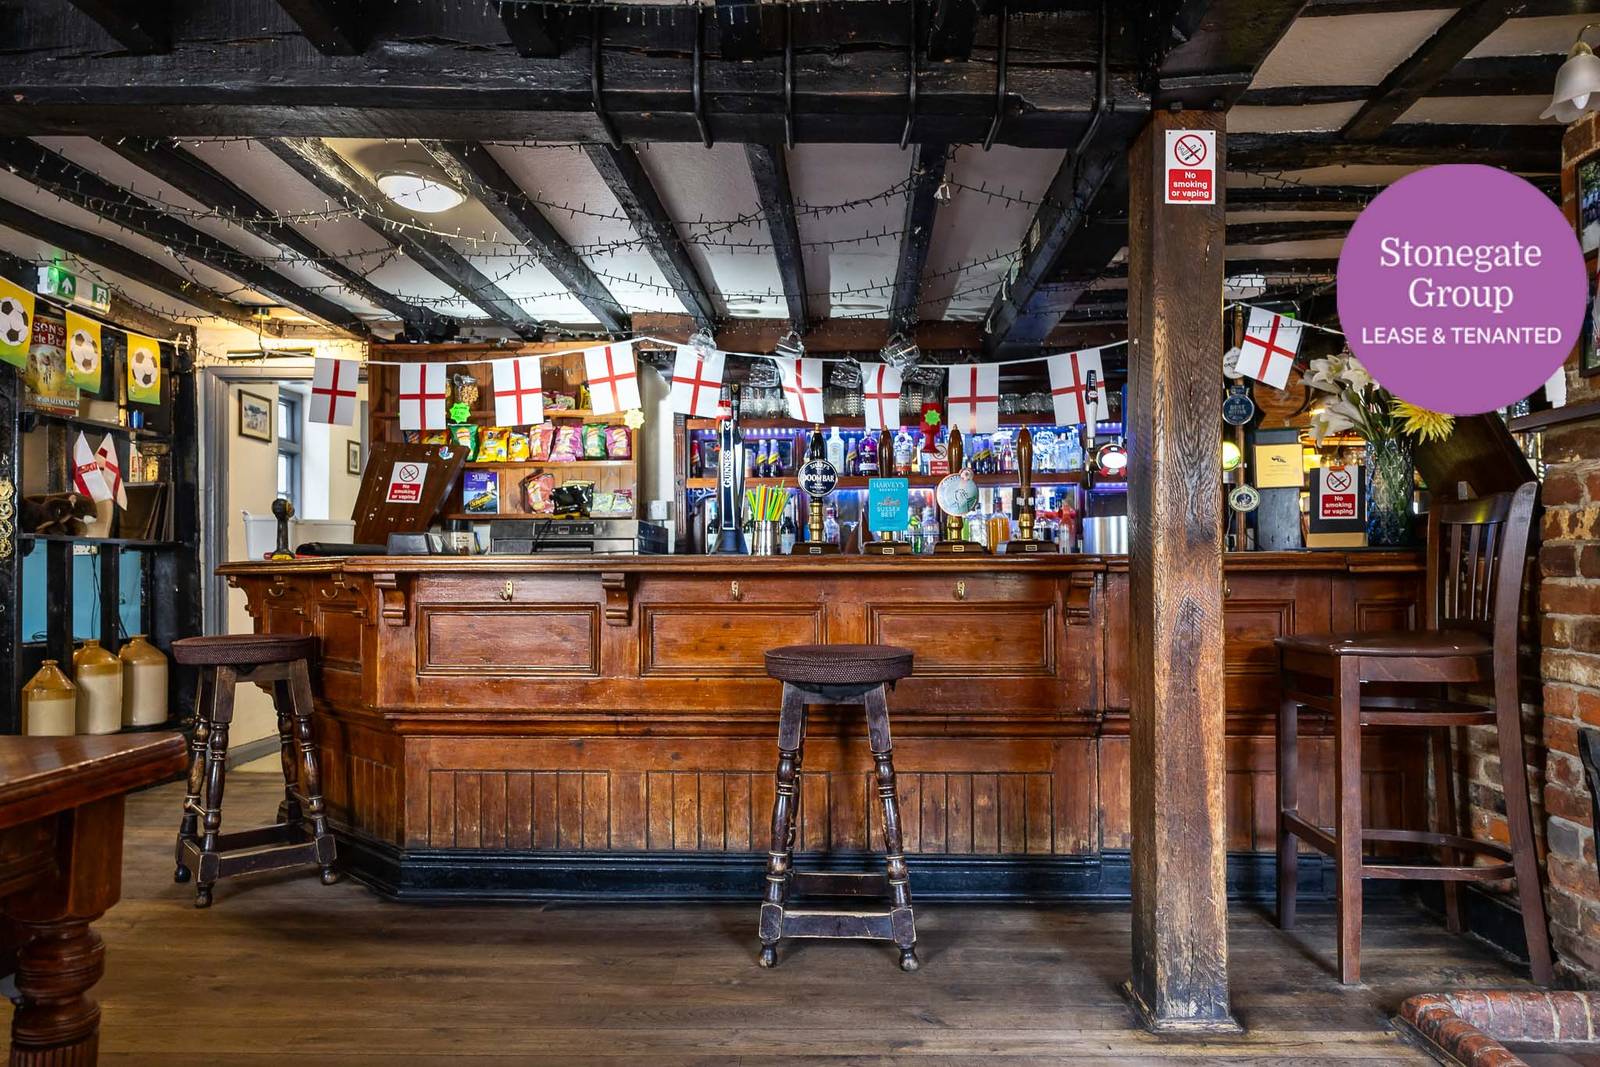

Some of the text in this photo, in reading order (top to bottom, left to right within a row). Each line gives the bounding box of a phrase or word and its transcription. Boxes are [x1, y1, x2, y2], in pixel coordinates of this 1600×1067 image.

[1184, 171, 1197, 179] No
[1173, 180, 1208, 190] smoking
[1182, 189, 1210, 199] vaping
[822, 474, 835, 482] BAR
